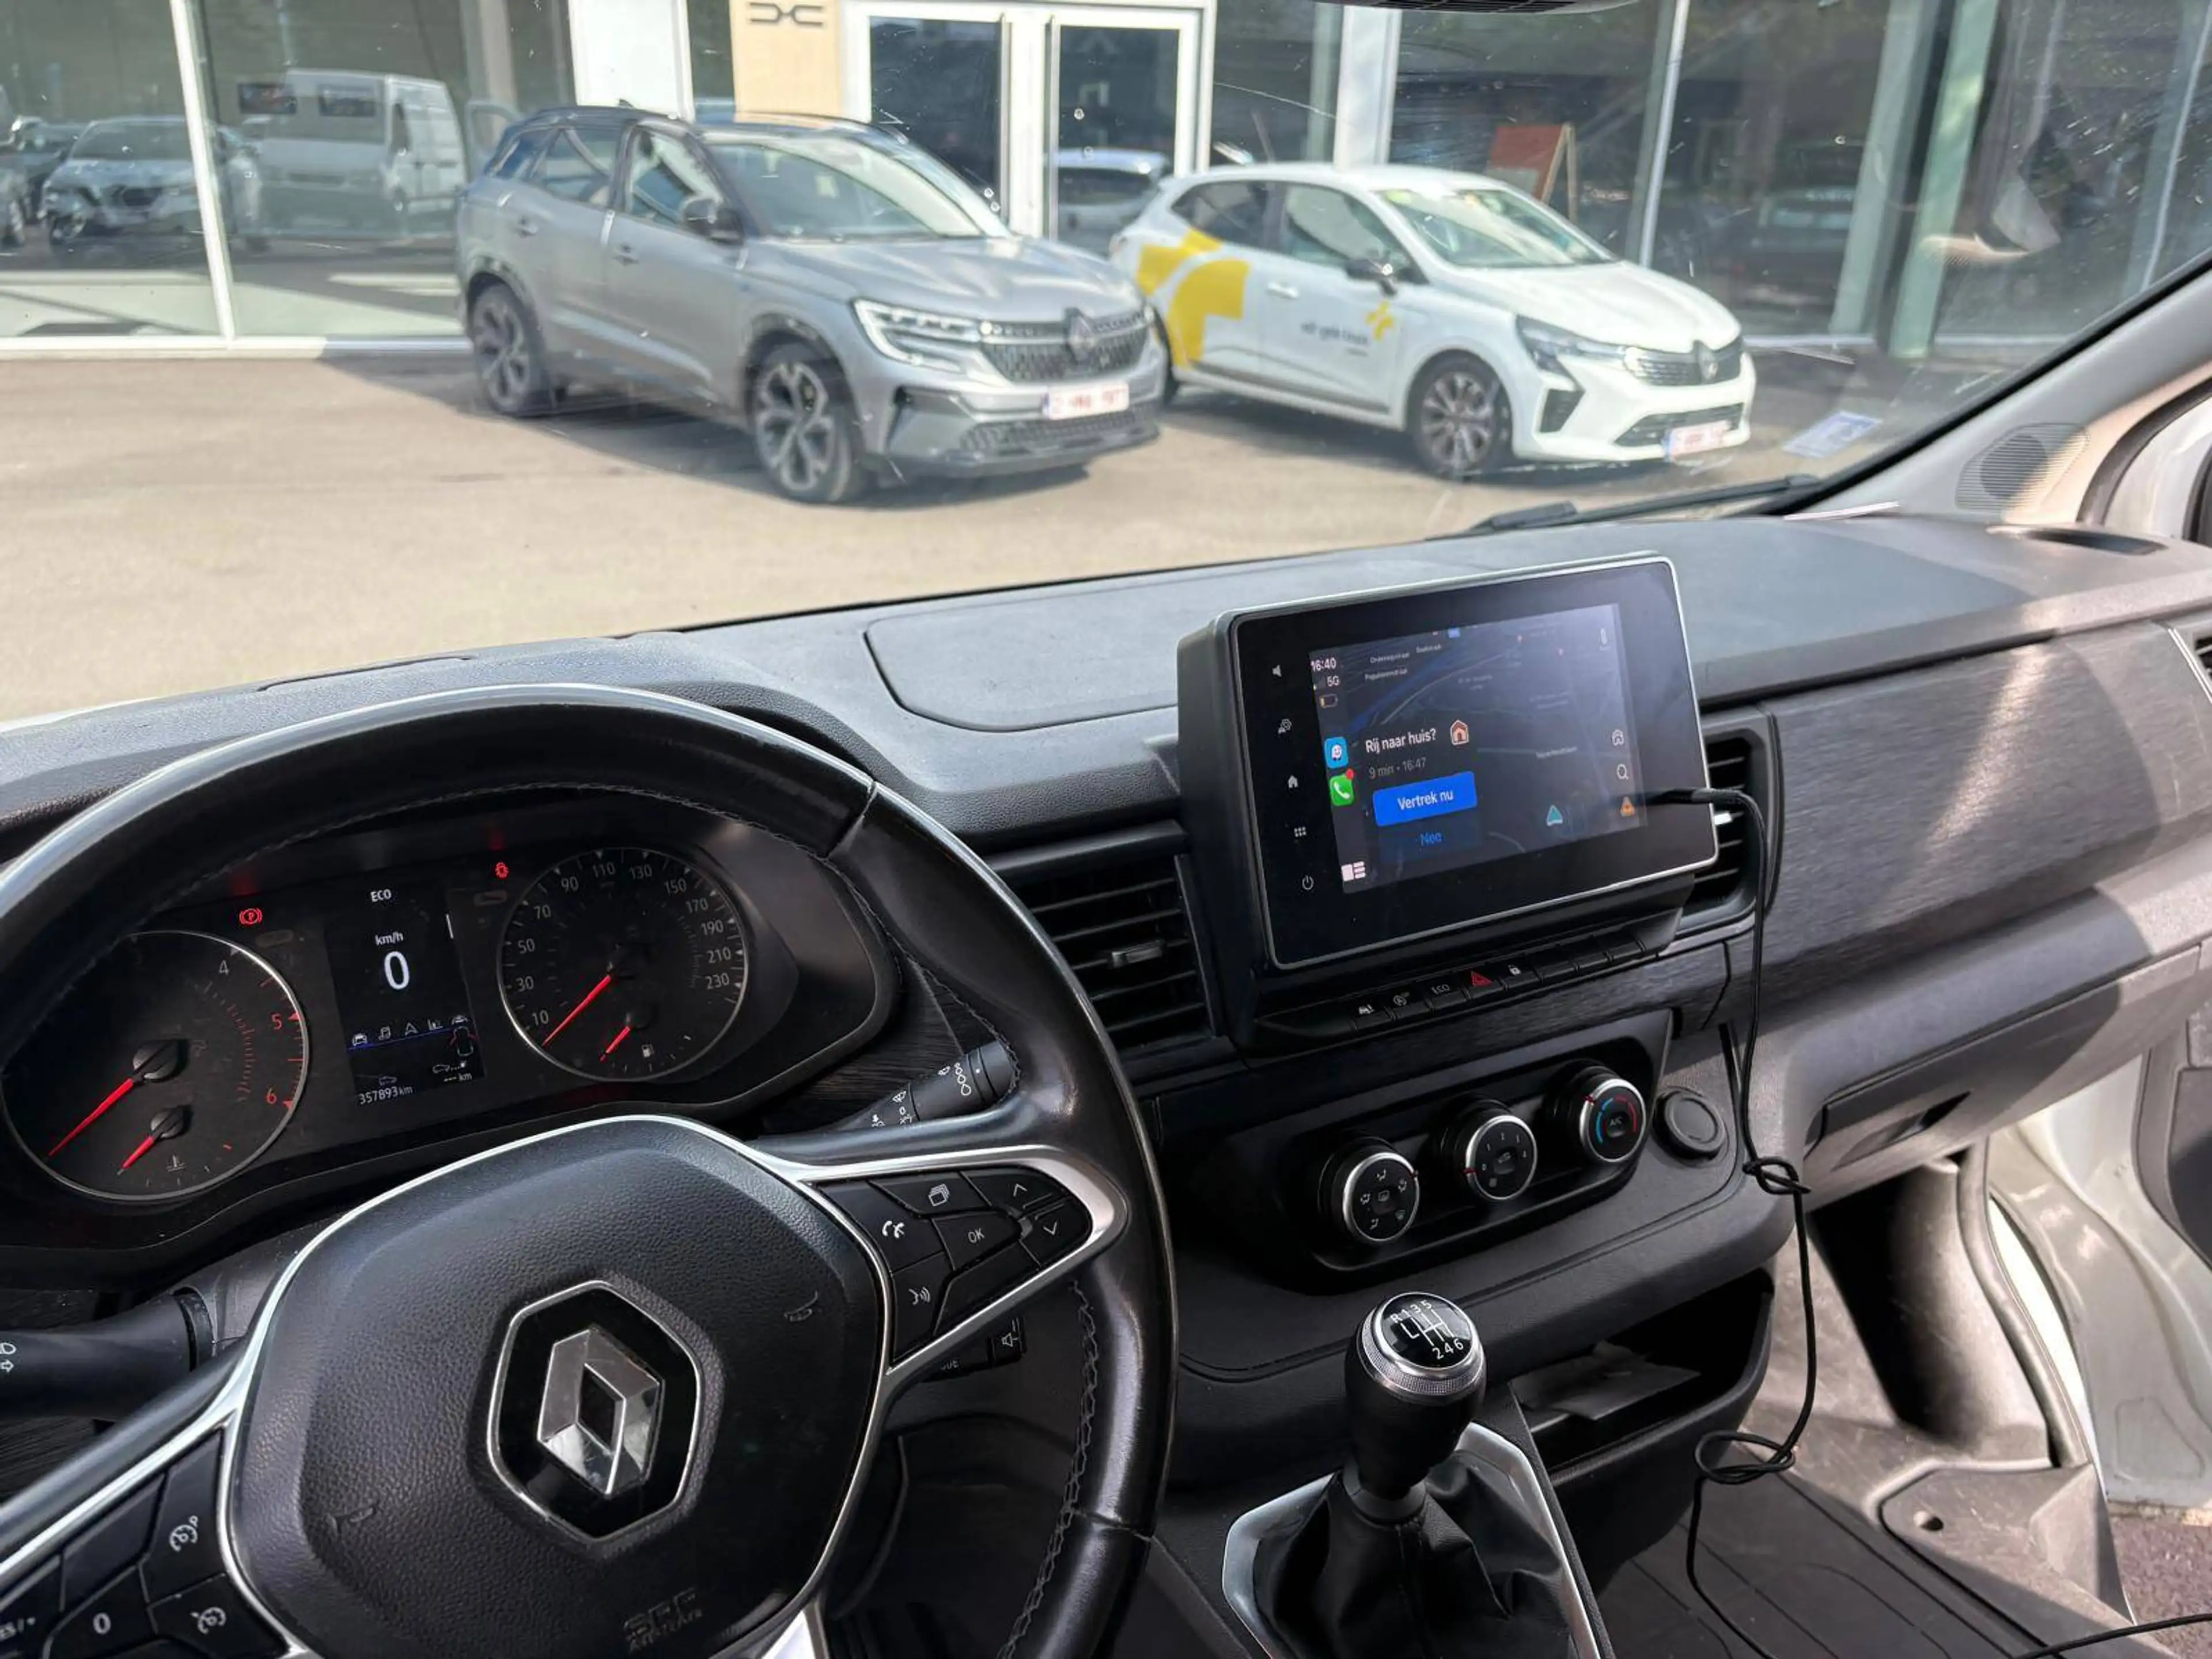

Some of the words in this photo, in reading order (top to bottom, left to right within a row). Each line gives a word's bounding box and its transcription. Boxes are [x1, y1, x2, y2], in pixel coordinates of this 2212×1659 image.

[1311, 657, 1336, 672] 16:40
[1365, 738, 1380, 754] Rij
[1382, 736, 1405, 750] naar
[1408, 728, 1437, 746] huis?
[1402, 757, 1426, 772] 16:47
[1397, 791, 1438, 810] Vertrek
[1440, 790, 1454, 801] nu
[593, 862, 616, 877] 110
[630, 865, 652, 880] 130
[561, 876, 578, 892] 90
[664, 878, 687, 894] 150
[370, 889, 392, 902] ECO
[533, 904, 552, 919] 70
[687, 898, 708, 914] 170
[701, 919, 724, 935] 190
[375, 931, 404, 946] km/h
[518, 938, 536, 954] 50
[707, 947, 732, 963] 210
[219, 960, 229, 975] 4
[384, 951, 410, 990] 0
[517, 976, 534, 993] 30
[706, 973, 730, 990] 230
[272, 1013, 282, 1029] 5
[532, 1010, 550, 1027] 10
[459, 1072, 472, 1081] km
[267, 1087, 277, 1104] 6
[967, 1229, 985, 1244] OK
[1391, 1313, 1403, 1323] R
[1410, 1304, 1421, 1313] 3
[1421, 1300, 1431, 1309] 5
[1432, 1347, 1444, 1360] 2
[1444, 1343, 1454, 1354] 4
[1453, 1338, 1464, 1350] 6
